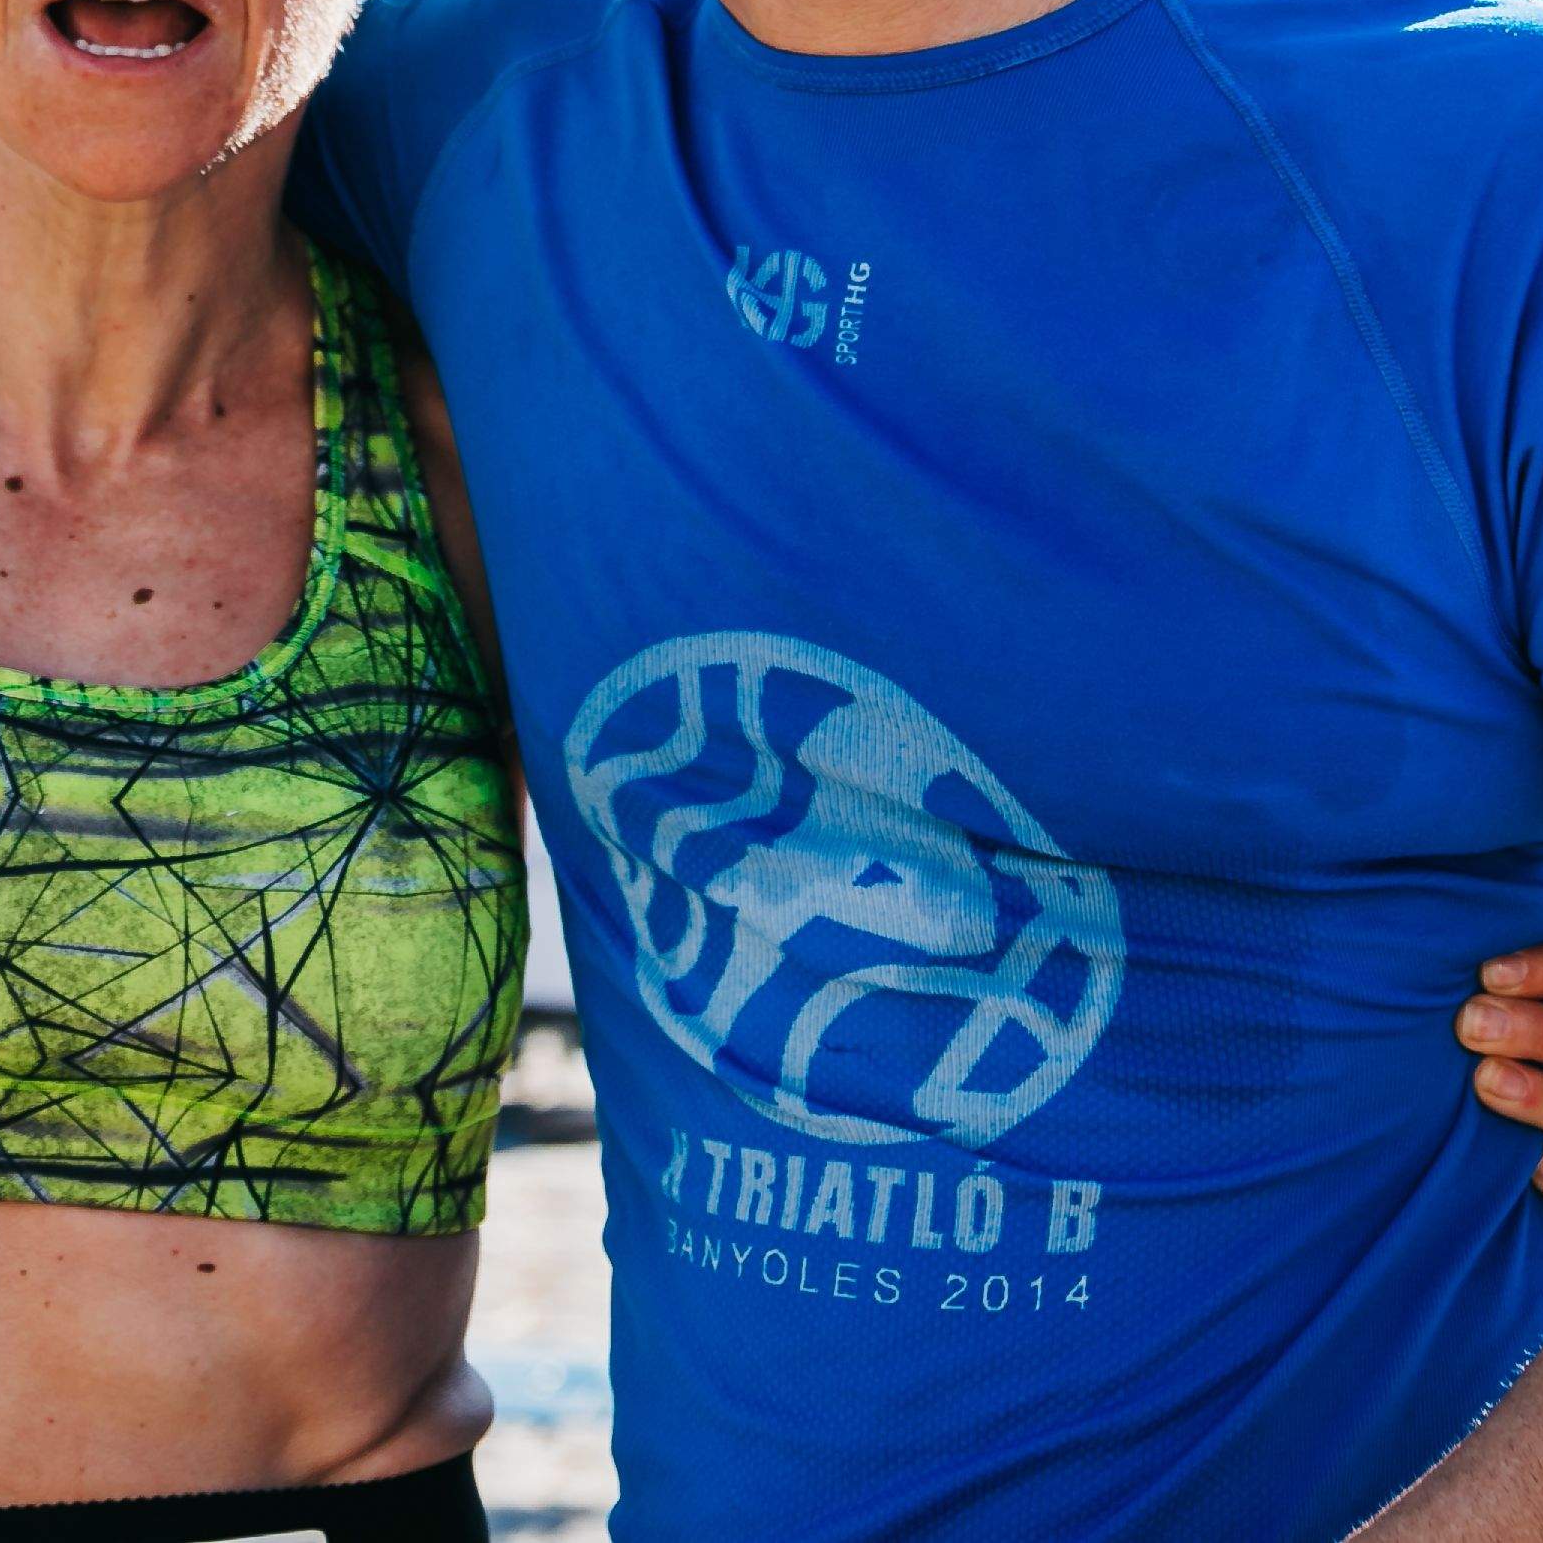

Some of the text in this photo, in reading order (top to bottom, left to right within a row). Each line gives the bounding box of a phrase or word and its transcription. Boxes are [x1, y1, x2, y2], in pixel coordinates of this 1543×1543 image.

[700, 1138, 1005, 1254] TRIATLÓ
[1045, 1179, 1103, 1254] B
[940, 1274, 1091, 1312] 2014
